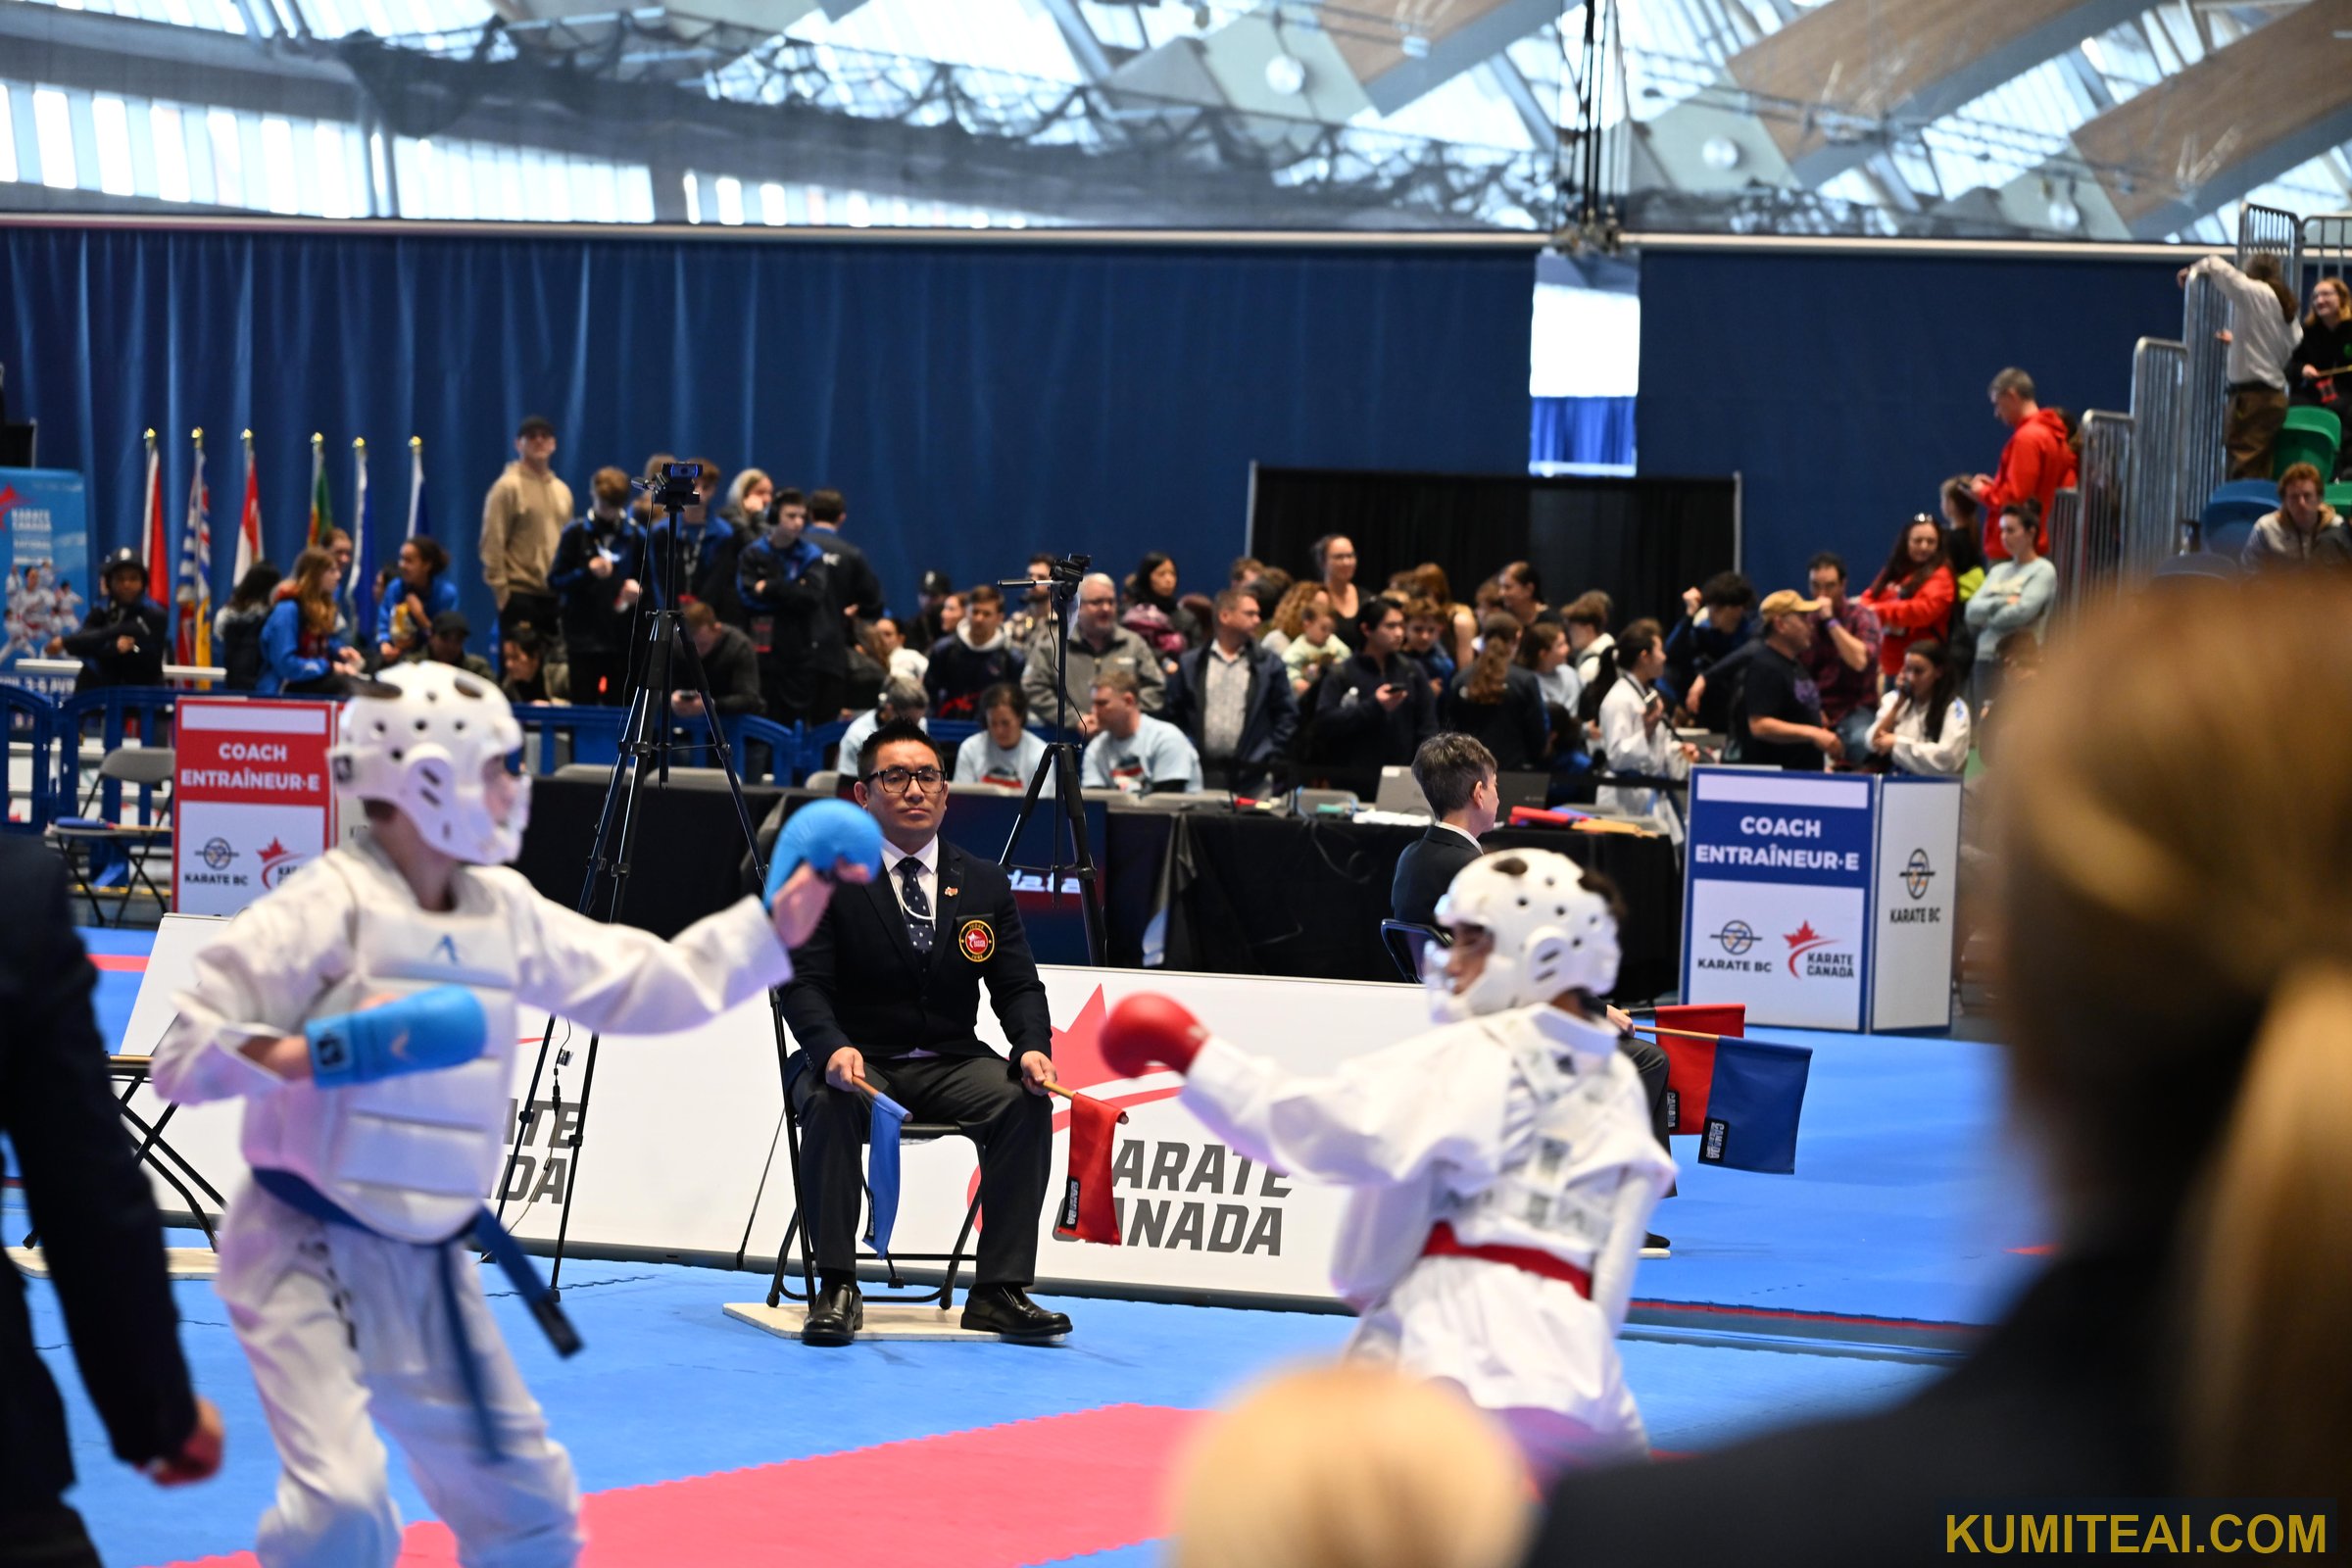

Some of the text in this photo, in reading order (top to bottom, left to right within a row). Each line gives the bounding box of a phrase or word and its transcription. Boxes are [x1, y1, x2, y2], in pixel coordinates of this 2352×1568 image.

[219, 742, 287, 762] COACH
[1740, 816, 1821, 838] COACH
[184, 873, 249, 887] KARATE BC
[1889, 906, 1941, 923] KARATE BC
[1697, 958, 1772, 973] KARATE BC
[1807, 952, 1854, 965] KARATE
[1807, 964, 1854, 979] CANADA
[1112, 1139, 1293, 1199] ARATE
